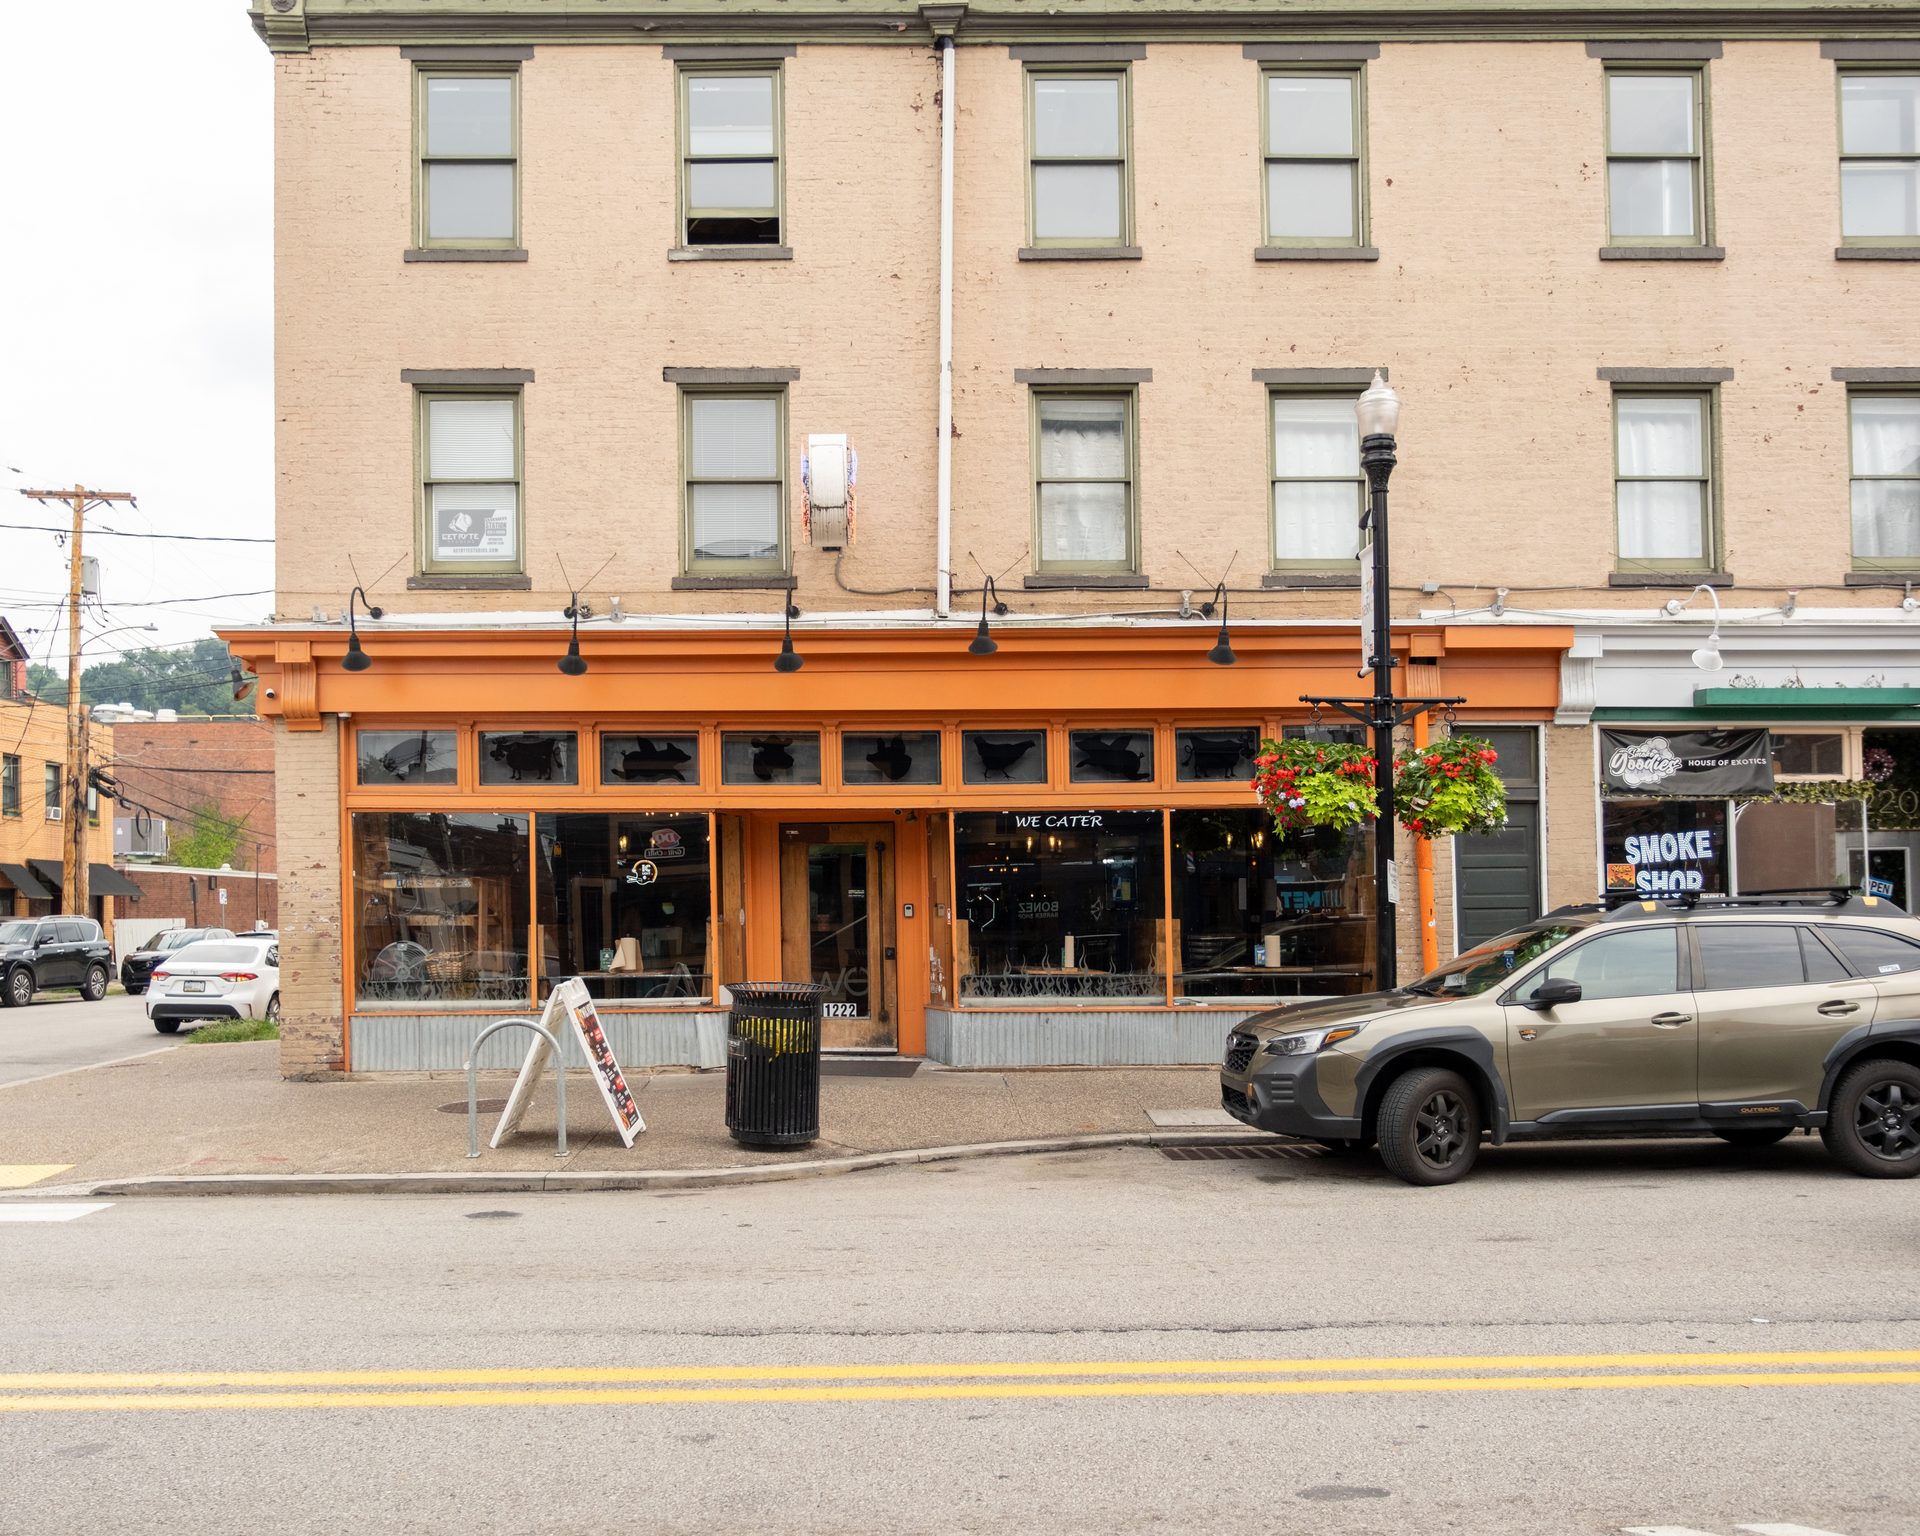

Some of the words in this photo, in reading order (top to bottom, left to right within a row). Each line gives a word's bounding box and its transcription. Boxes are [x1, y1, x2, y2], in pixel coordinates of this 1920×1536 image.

[1688, 759, 1716, 767] HOUSE
[1731, 758, 1767, 766] EXOTICS
[1015, 815, 1041, 828] WE
[1045, 815, 1103, 828] CATER
[1624, 830, 1713, 865] SMOKE
[1863, 879, 1889, 895] PEN
[824, 1003, 856, 1017] 1222
